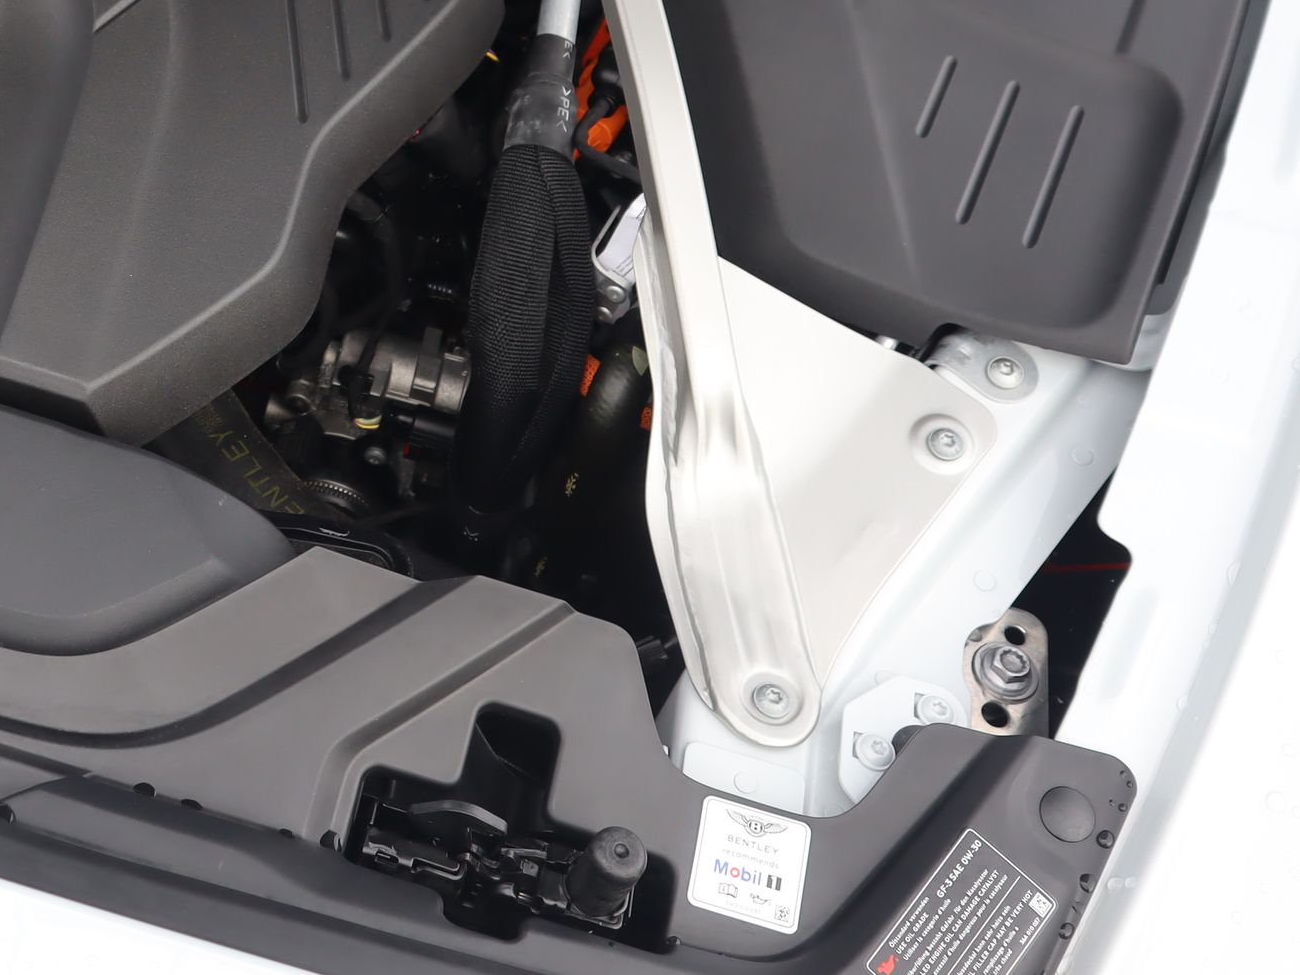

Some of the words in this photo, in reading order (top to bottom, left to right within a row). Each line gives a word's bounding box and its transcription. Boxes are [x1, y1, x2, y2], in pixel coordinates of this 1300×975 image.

[722, 848, 780, 870] recommends
[727, 834, 780, 855] BENTLEY
[948, 863, 964, 881] SAE
[960, 839, 982, 865] 0W-30
[714, 858, 762, 886] Mobil
[895, 941, 907, 954] USE
[904, 931, 915, 942] OIL
[912, 912, 929, 932] GRADE
[928, 941, 947, 964] ENGINE
[944, 931, 954, 943] OIL
[951, 919, 963, 932] CAN
[960, 895, 980, 920] DAMAGE
[977, 870, 1000, 896] CATALYST
[972, 950, 990, 971] FILLER
[987, 938, 998, 951] CAP
[995, 925, 1007, 939] MAY
[1004, 916, 1014, 927] BE
[1010, 901, 1025, 918] VERY
[1021, 890, 1033, 903] HOT
